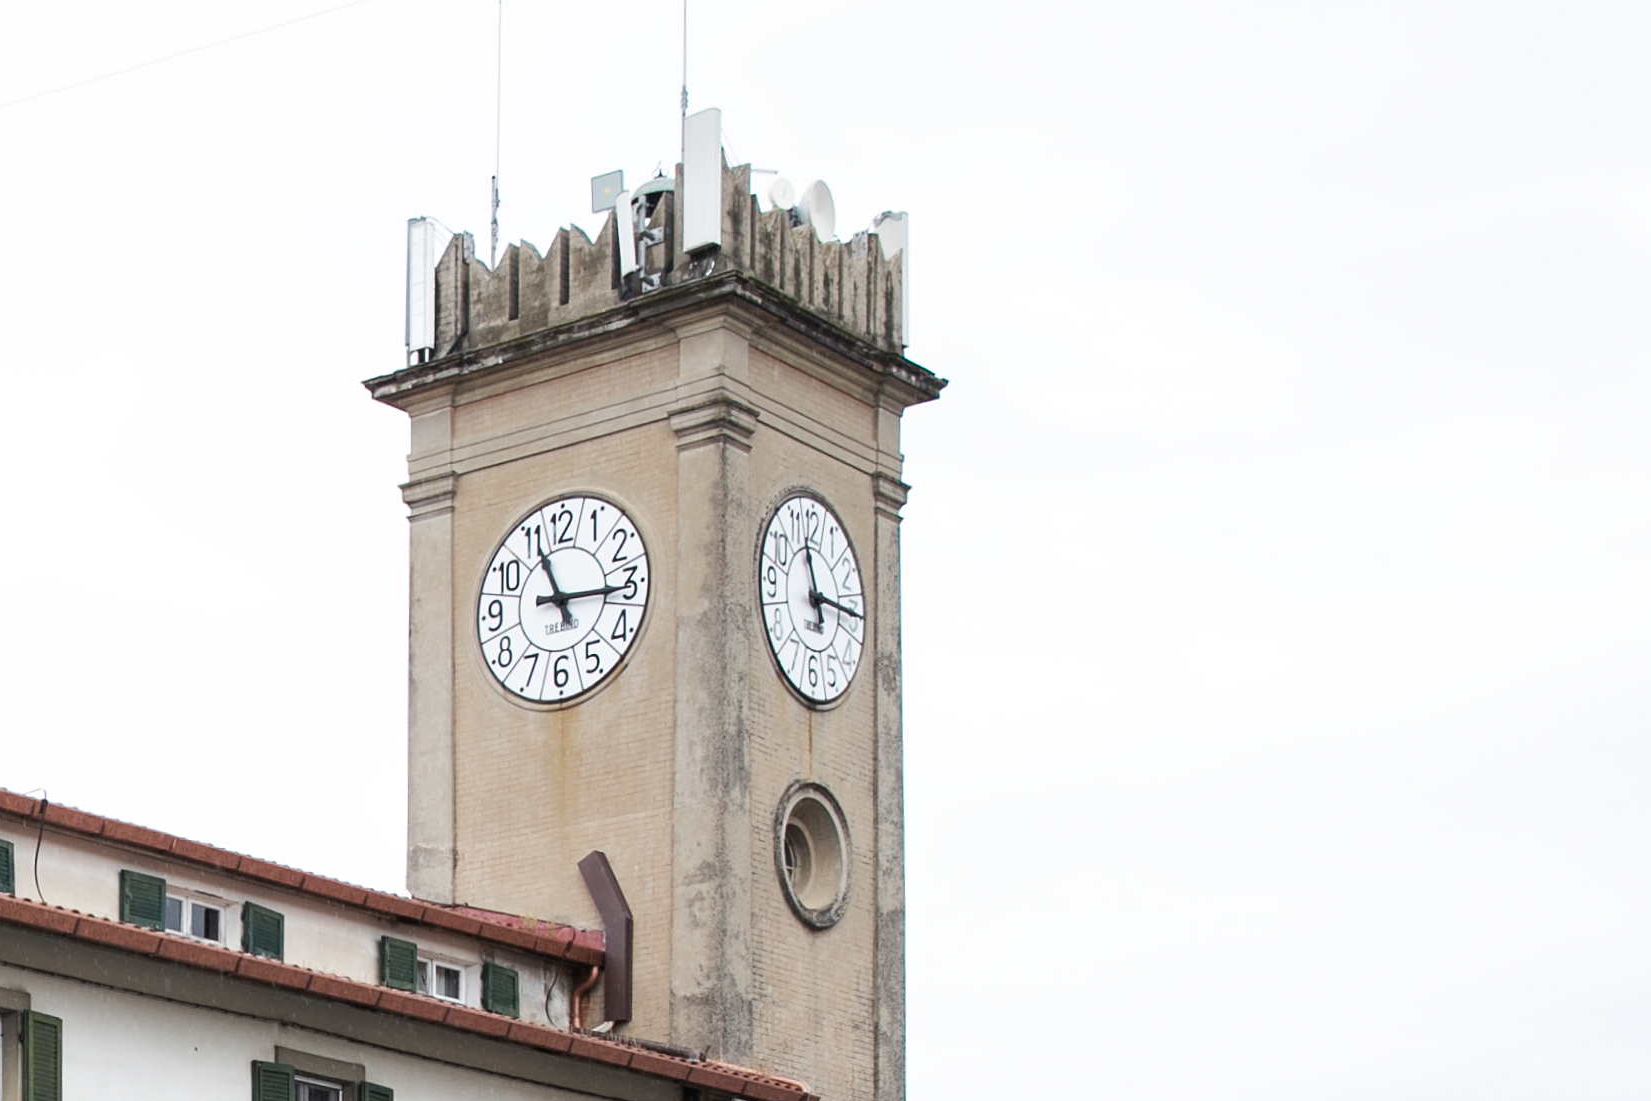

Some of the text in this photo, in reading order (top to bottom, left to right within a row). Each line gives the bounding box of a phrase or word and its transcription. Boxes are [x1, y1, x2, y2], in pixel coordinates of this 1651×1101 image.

[524, 524, 541, 559] 11
[550, 510, 573, 545] 12
[590, 509, 597, 542] 1
[789, 509, 800, 545] 11
[805, 509, 820, 547] 12
[830, 526, 834, 558] 1
[612, 528, 628, 563] 2
[773, 530, 787, 566] 10
[498, 560, 520, 593] 10
[622, 565, 638, 600] 3
[767, 566, 777, 598] 9
[842, 557, 852, 591] 2
[488, 599, 503, 632] 9
[611, 609, 626, 642] 4
[773, 608, 783, 641] 8
[497, 636, 512, 667] 8
[585, 639, 601, 673] 5
[790, 638, 800, 671] 7
[842, 639, 852, 671] 4
[524, 653, 539, 687] 7
[553, 655, 569, 687] 6
[808, 655, 818, 687] 6
[827, 654, 836, 687] 5
